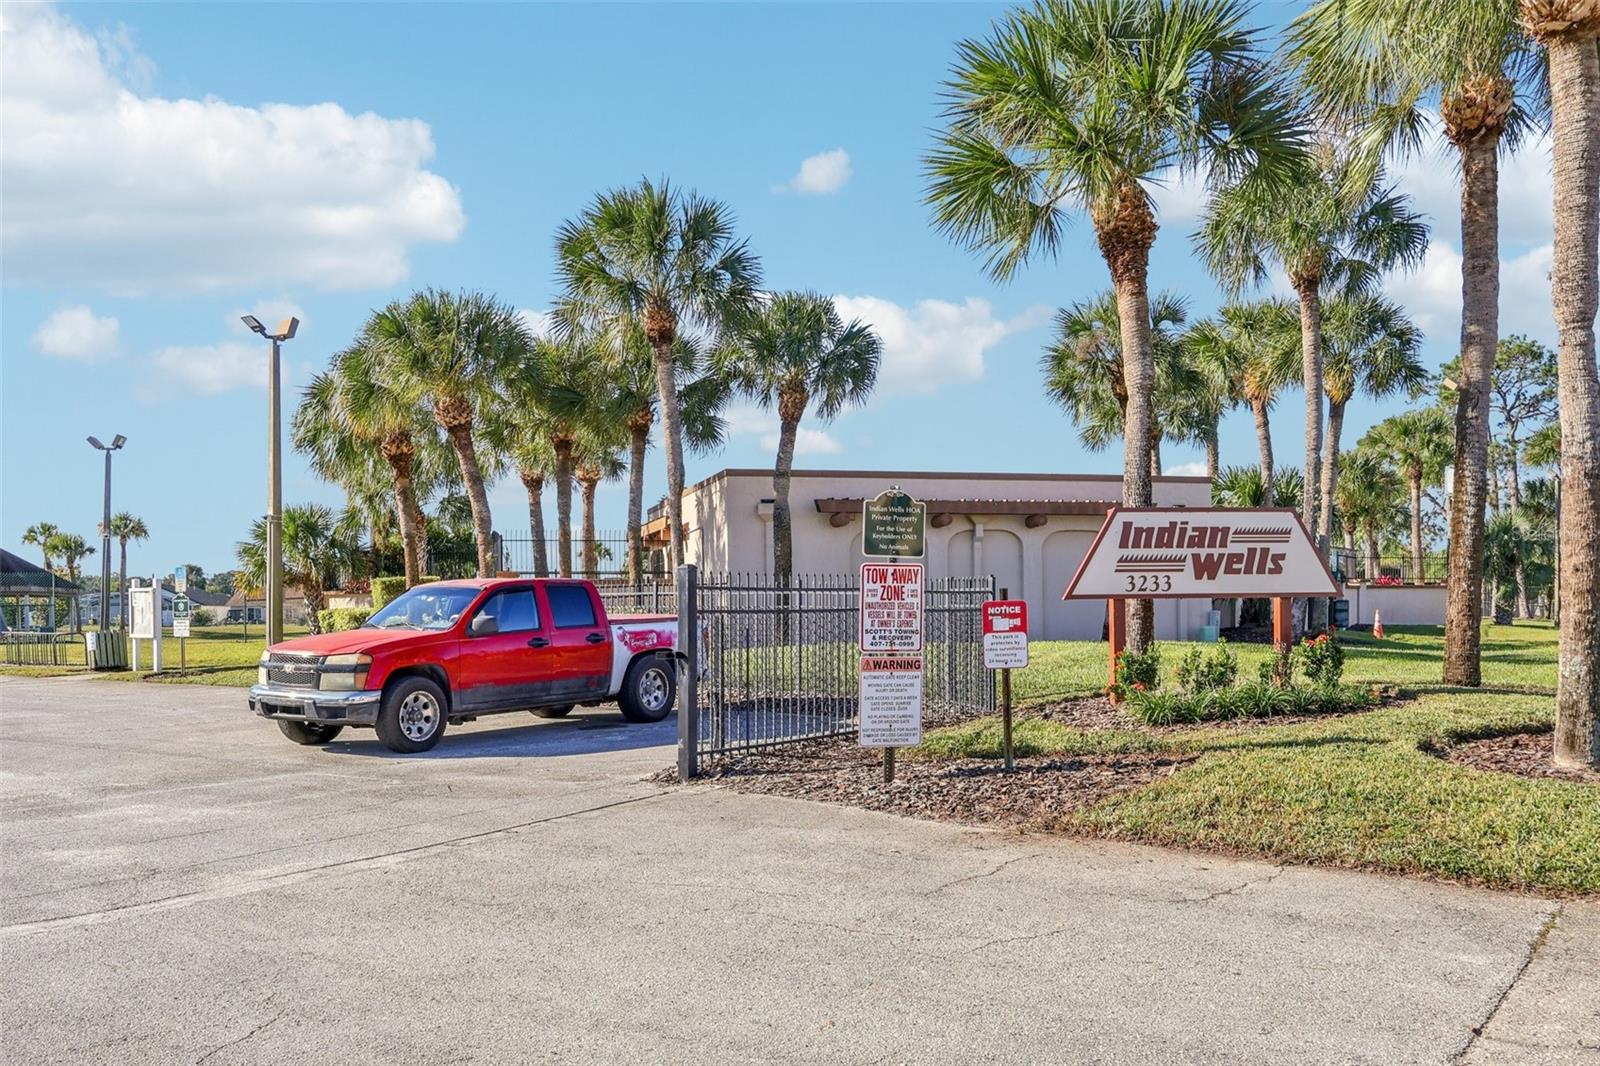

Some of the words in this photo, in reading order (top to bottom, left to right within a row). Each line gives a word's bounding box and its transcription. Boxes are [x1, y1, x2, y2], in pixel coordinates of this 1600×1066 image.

[893, 514, 918, 524] Property
[1118, 521, 1231, 549] Indian
[1191, 547, 1287, 580] Wells
[866, 568, 888, 584] TOW
[891, 568, 920, 584] AWAY
[1125, 575, 1172, 592] 3233
[880, 585, 906, 600] ZONE
[864, 602, 896, 610] UNAUTHORIZED
[897, 602, 915, 610] VEHICLES
[988, 606, 1021, 614] NOTICE
[868, 611, 884, 619] VESSELS
[886, 611, 896, 619] WILL
[897, 611, 902, 619] BE
[904, 611, 917, 619] TOWED
[870, 620, 876, 628] AT
[896, 620, 914, 628] EXPENSE
[873, 660, 921, 670] WARNING
